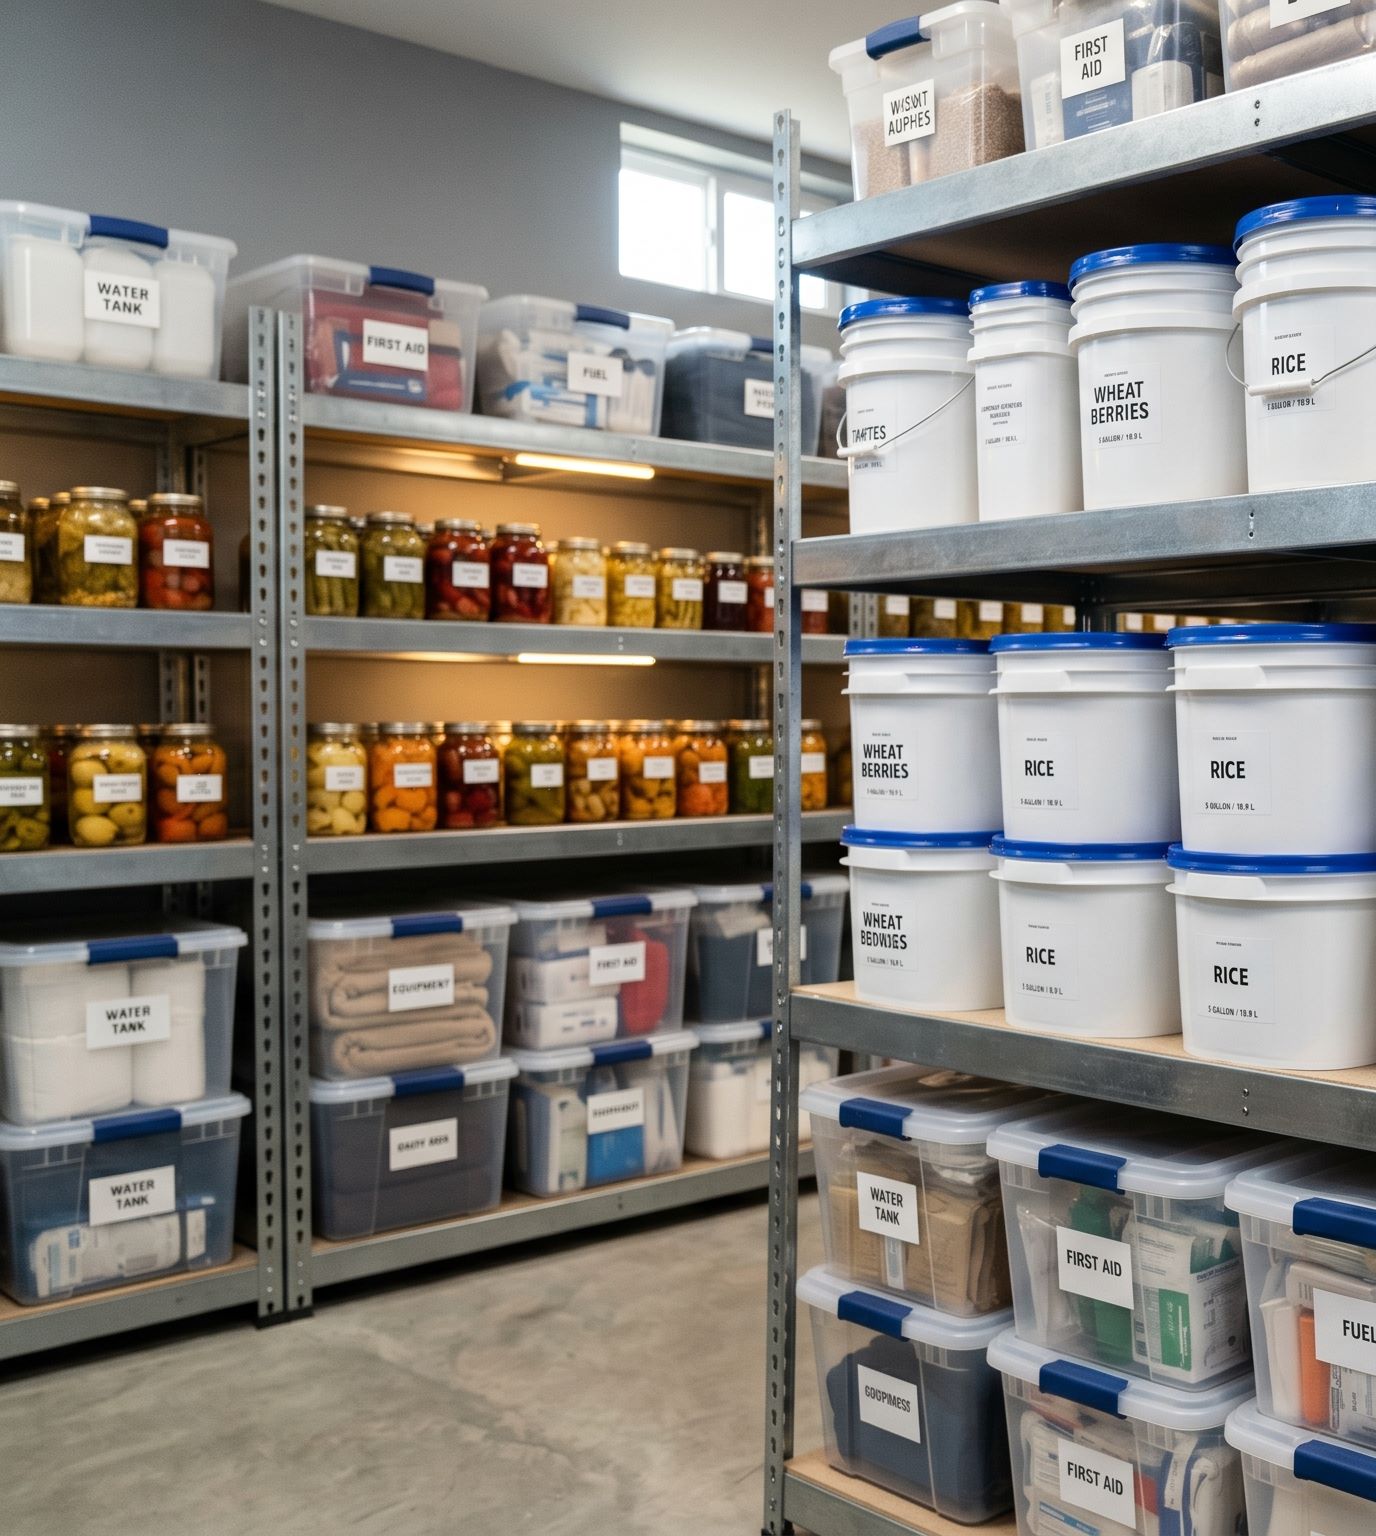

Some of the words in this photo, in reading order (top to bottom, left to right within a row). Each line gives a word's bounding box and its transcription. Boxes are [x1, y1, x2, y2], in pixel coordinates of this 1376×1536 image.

[1075, 36, 1108, 61] FIRST
[1082, 59, 1102, 80] AID
[97, 282, 149, 301] WATER
[103, 298, 142, 315] TANK
[367, 335, 402, 351] FIRST
[1272, 353, 1306, 375] RICE
[583, 367, 608, 381] FUEL
[1094, 381, 1144, 404] WHEAT
[1091, 401, 1149, 425] BERRIES
[863, 743, 903, 760] WHEAT
[861, 762, 909, 779] BERRIES
[1025, 759, 1055, 777] RICE
[1210, 760, 1246, 779] RICE
[1026, 946, 1056, 966] RICE
[1213, 965, 1249, 986] RICE
[106, 1005, 151, 1021] WATER
[112, 1020, 146, 1034] TANK
[110, 1179, 155, 1197] WATER
[870, 1186, 904, 1208] WATER
[116, 1195, 149, 1210] TANK
[875, 1206, 900, 1226] TANK
[1066, 1249, 1099, 1271] FIRST
[1102, 1259, 1122, 1277] AID
[1067, 1461, 1100, 1486] FIRST
[1103, 1475, 1123, 1495] AID
